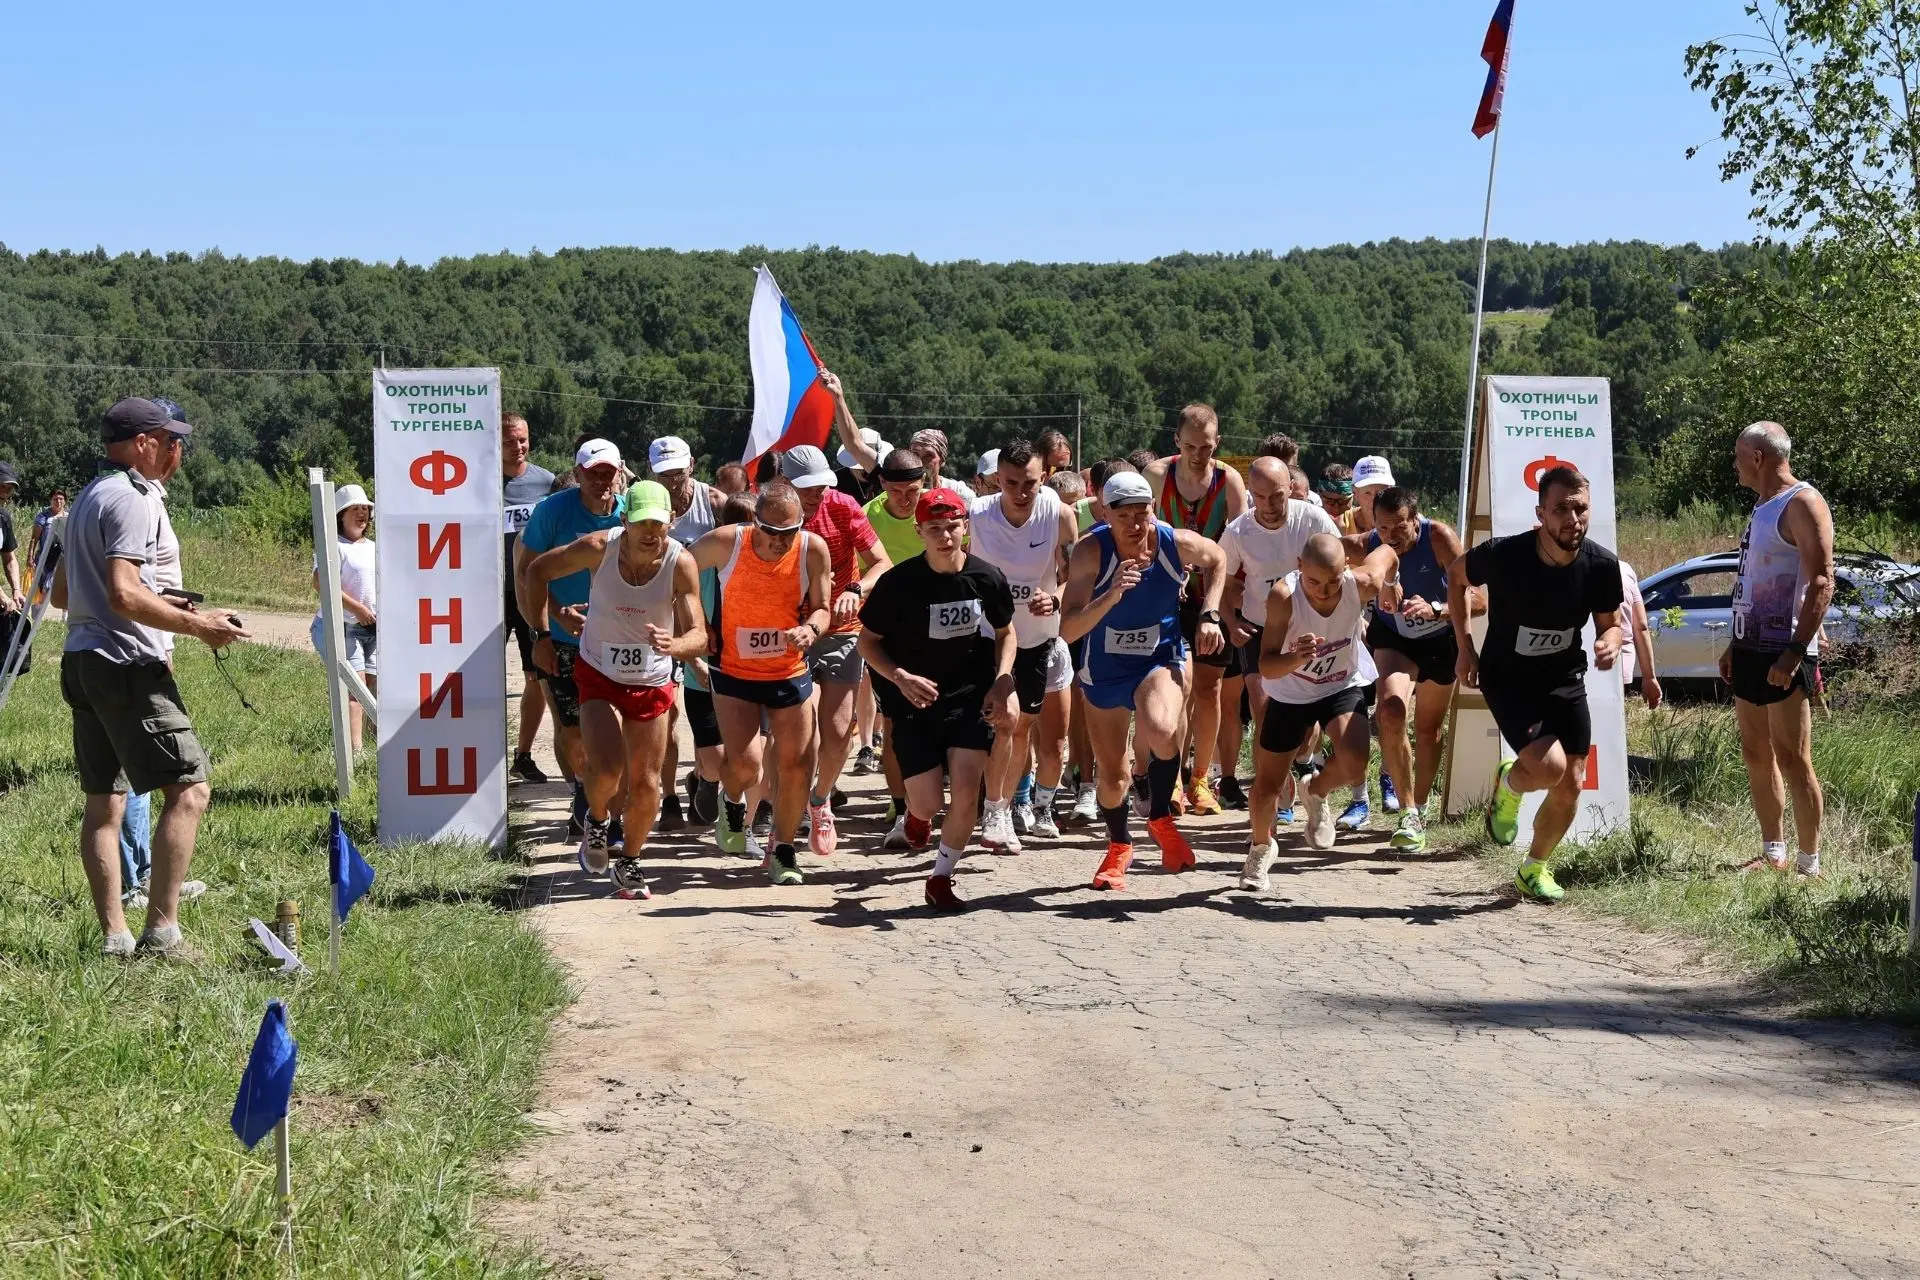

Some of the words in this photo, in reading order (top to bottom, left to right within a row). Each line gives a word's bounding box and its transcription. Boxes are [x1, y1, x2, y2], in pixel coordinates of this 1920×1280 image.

[385, 384, 488, 397] ОХОТНИЧЬИ
[1499, 392, 1598, 405] ОХОТНИЧЬИ
[407, 402, 466, 415] ТРОПЫ
[1520, 409, 1577, 421] ТРОПЫ
[390, 419, 485, 432] ТУРГЕНЕВА
[1504, 425, 1595, 438] ТУРГЕНЕВА
[505, 508, 530, 523] 753
[1009, 584, 1031, 600] 59
[407, 450, 478, 796] ФИНИШ
[939, 606, 971, 626] 528
[750, 631, 779, 648] 501
[1114, 631, 1148, 645] 735
[1529, 632, 1562, 647] 770
[610, 647, 642, 666] 738
